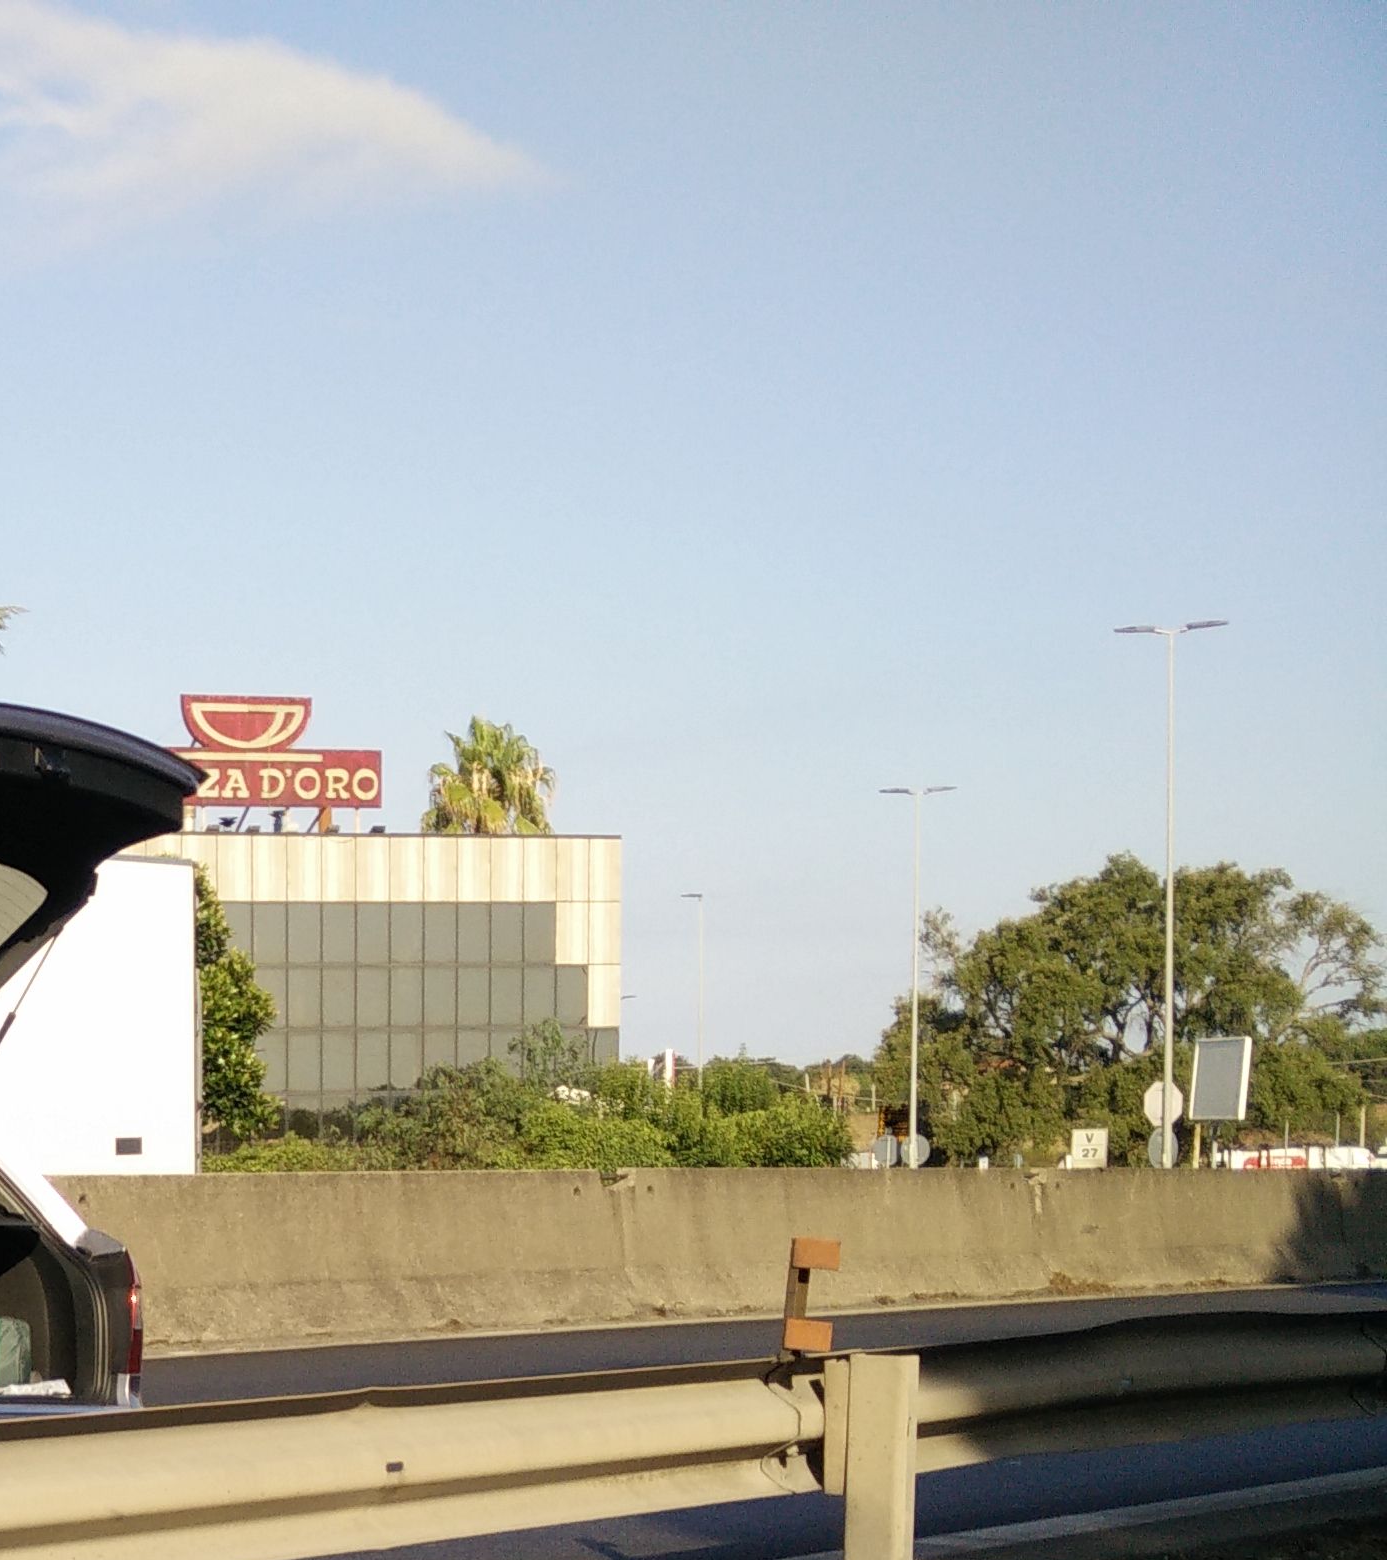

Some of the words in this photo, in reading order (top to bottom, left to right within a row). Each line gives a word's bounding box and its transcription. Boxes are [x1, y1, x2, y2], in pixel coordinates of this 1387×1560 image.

[197, 767, 250, 798] ZA
[259, 767, 379, 800] D'ORO
[1081, 1147, 1099, 1158] 27
